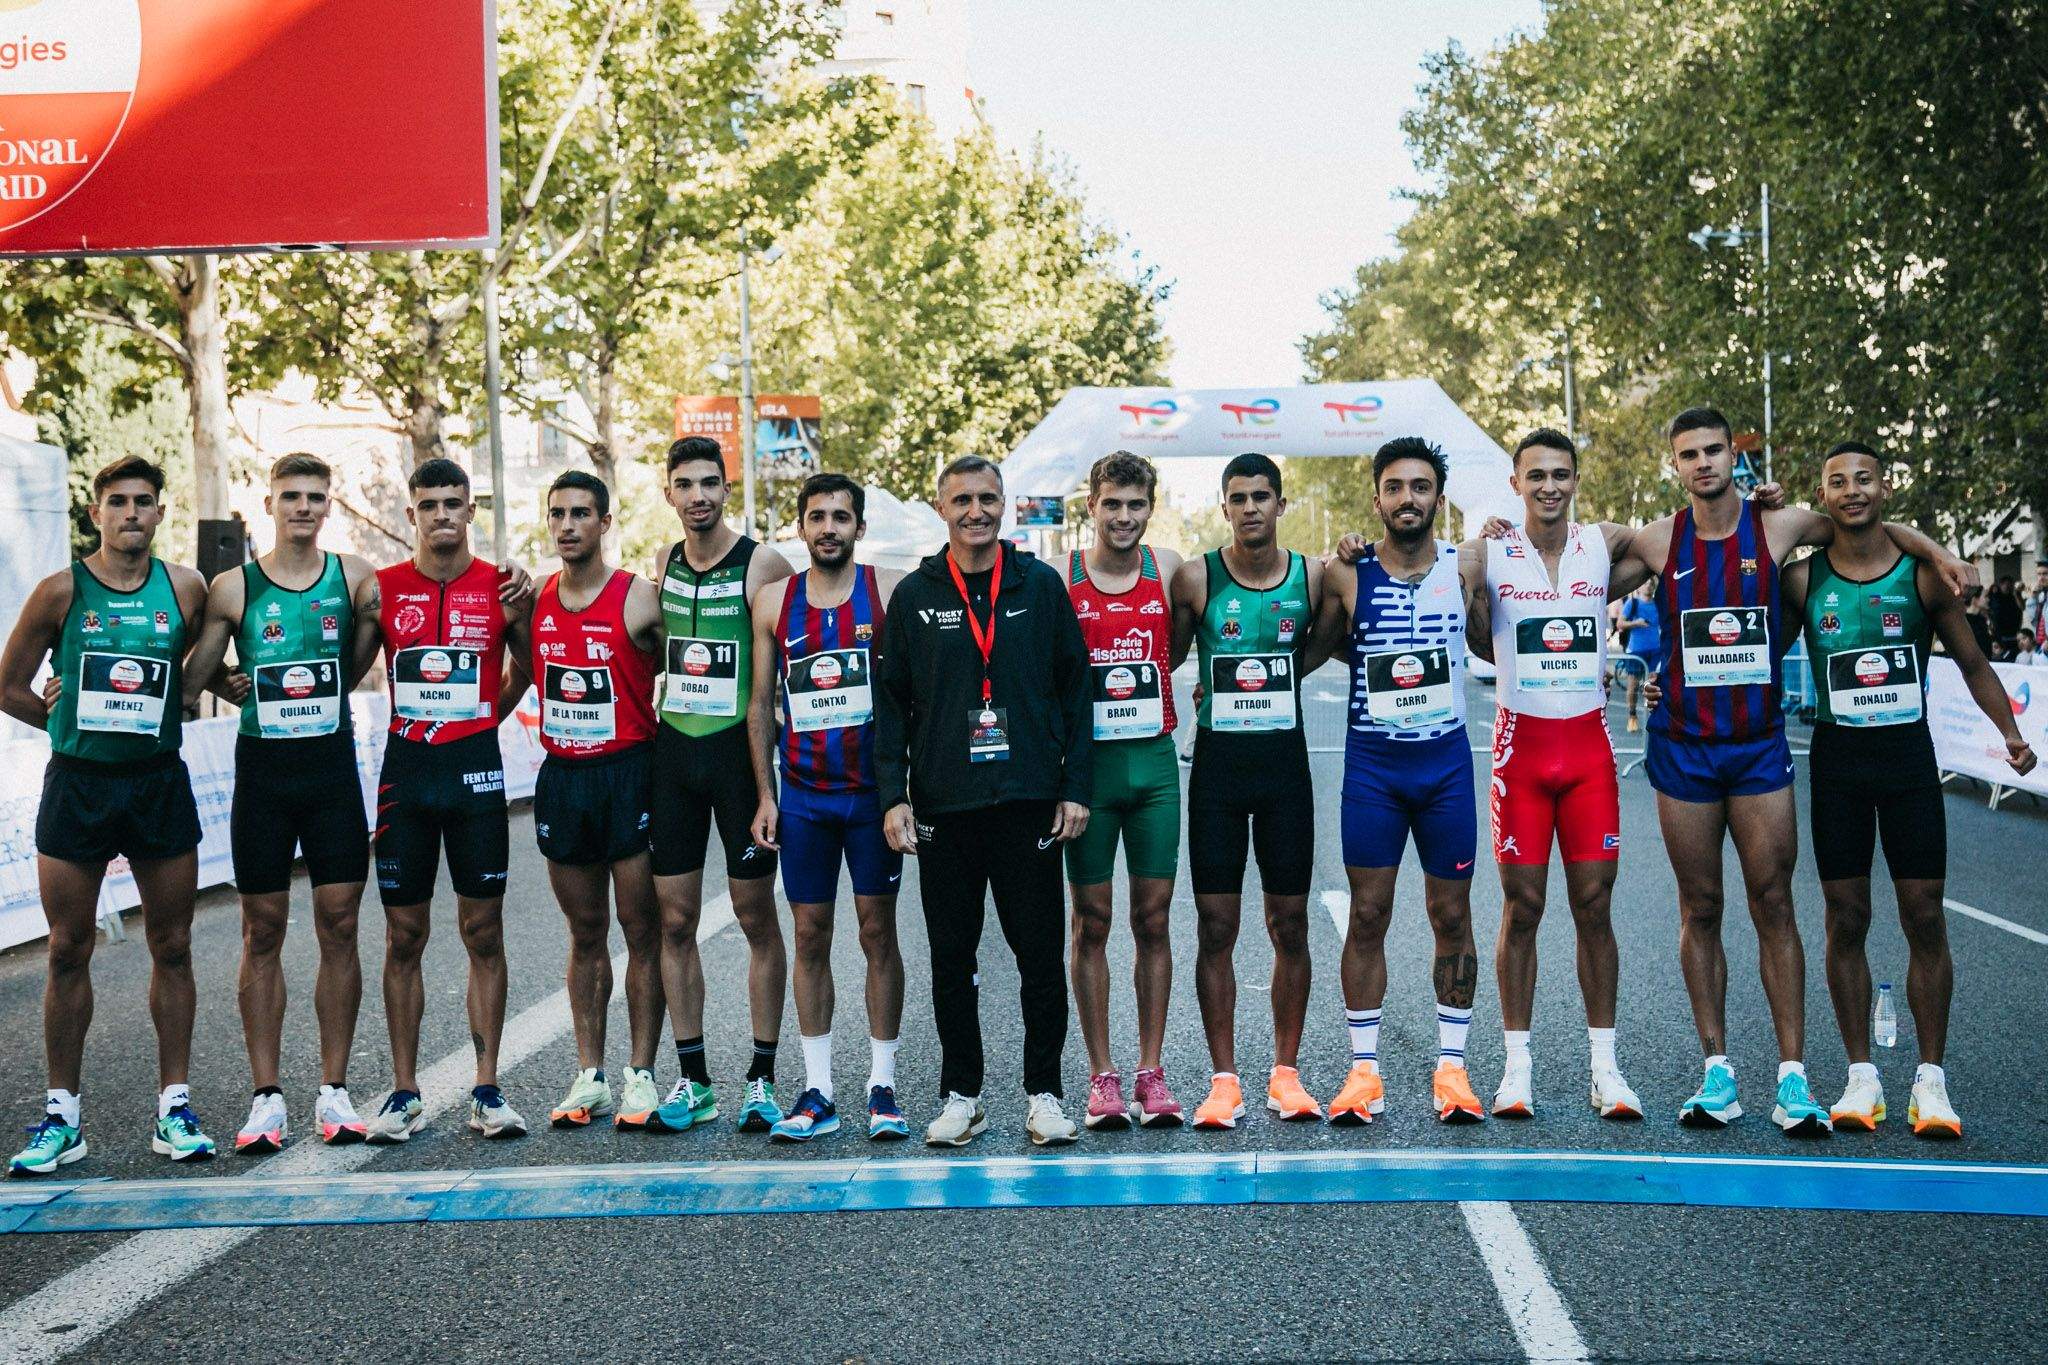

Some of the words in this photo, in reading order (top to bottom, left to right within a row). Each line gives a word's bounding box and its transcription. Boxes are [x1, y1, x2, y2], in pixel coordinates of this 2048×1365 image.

[1498, 583, 1561, 602] Puerto
[1570, 581, 1605, 599] Rico
[701, 605, 739, 616] CORDOBÉS
[935, 609, 963, 618] VICKY
[938, 616, 961, 624] FOODS
[1746, 611, 1757, 630] 2
[1575, 619, 1593, 637] 12
[1113, 638, 1142, 648] Patria
[458, 652, 470, 670] 6
[715, 645, 731, 663] 11
[1429, 651, 1440, 670] 1
[1697, 652, 1755, 665] VALLADARES
[1894, 650, 1907, 669] 5
[847, 653, 860, 672] 4
[1269, 658, 1288, 676] 10
[1540, 659, 1578, 670] VILCHES
[151, 663, 161, 682] 7
[320, 664, 332, 682] 3
[1141, 665, 1151, 684] 8
[592, 671, 604, 690] 9
[419, 690, 451, 700] NACHO
[681, 682, 709, 694] DOBAO
[104, 699, 144, 712] JIMENEZ
[811, 695, 847, 709] GONTXO
[1234, 699, 1271, 710] ATTAOUI
[1395, 694, 1427, 708] CARRO
[1853, 692, 1898, 706] RONALDO
[280, 705, 322, 718] QUIJALEX
[551, 707, 560, 718] DE
[561, 709, 570, 719] LA
[572, 710, 600, 721] TORRE
[1107, 706, 1138, 719] BRAVO
[463, 772, 487, 785] FENT
